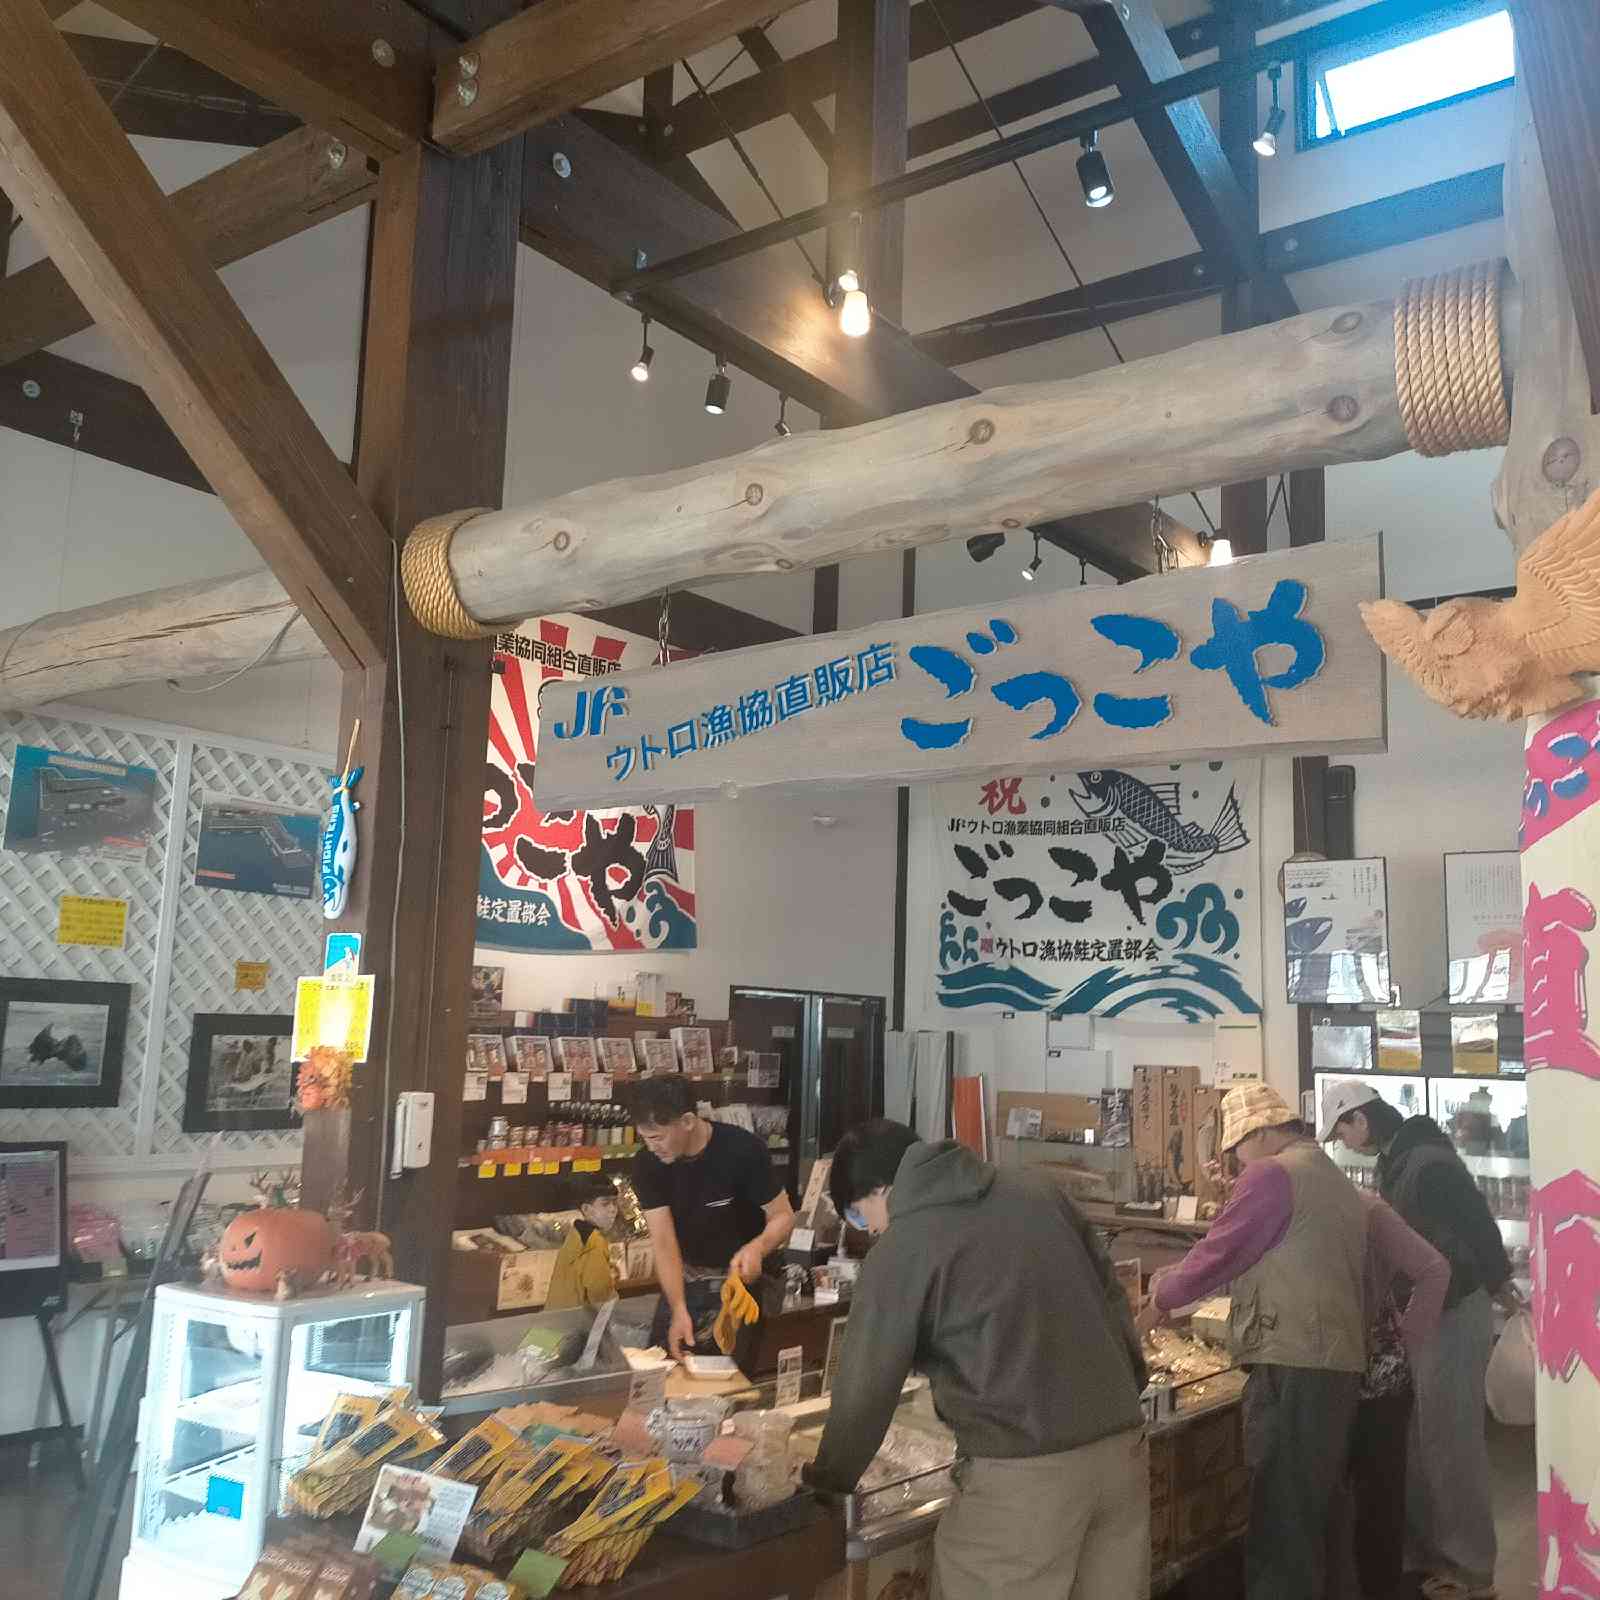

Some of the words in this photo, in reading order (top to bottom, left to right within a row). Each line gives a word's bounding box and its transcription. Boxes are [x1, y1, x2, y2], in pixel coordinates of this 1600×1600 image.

[607, 641, 899, 782] ウトロ漁協直販店
[900, 579, 1327, 751] ごっこや
[978, 776, 1027, 815] 祝
[947, 838, 1173, 926] ごっこや
